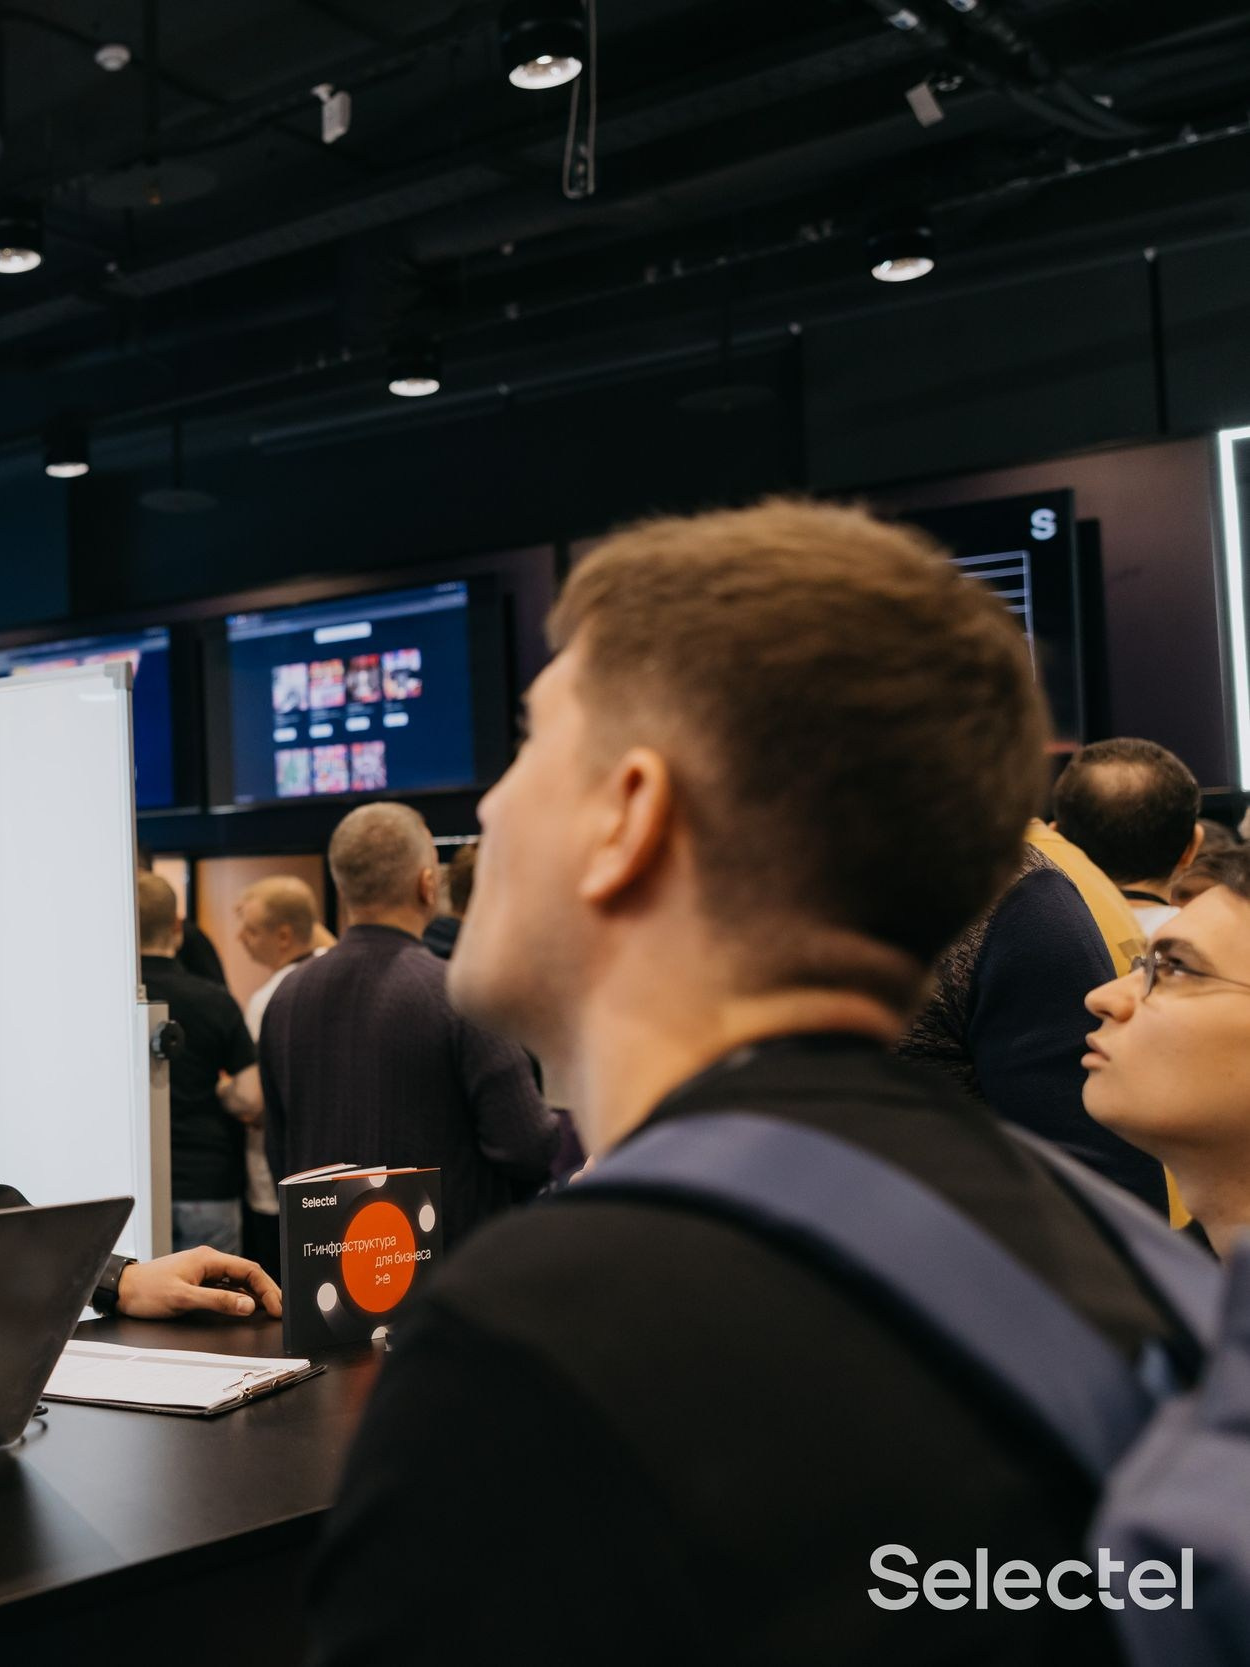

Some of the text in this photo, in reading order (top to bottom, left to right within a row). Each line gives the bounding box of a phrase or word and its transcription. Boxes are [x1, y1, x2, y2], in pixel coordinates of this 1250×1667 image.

[1030, 508, 1057, 540] S
[302, 1195, 337, 1208] Selectel
[303, 1235, 397, 1257] IT-инфраструктура
[375, 1248, 431, 1268] для бизнеса
